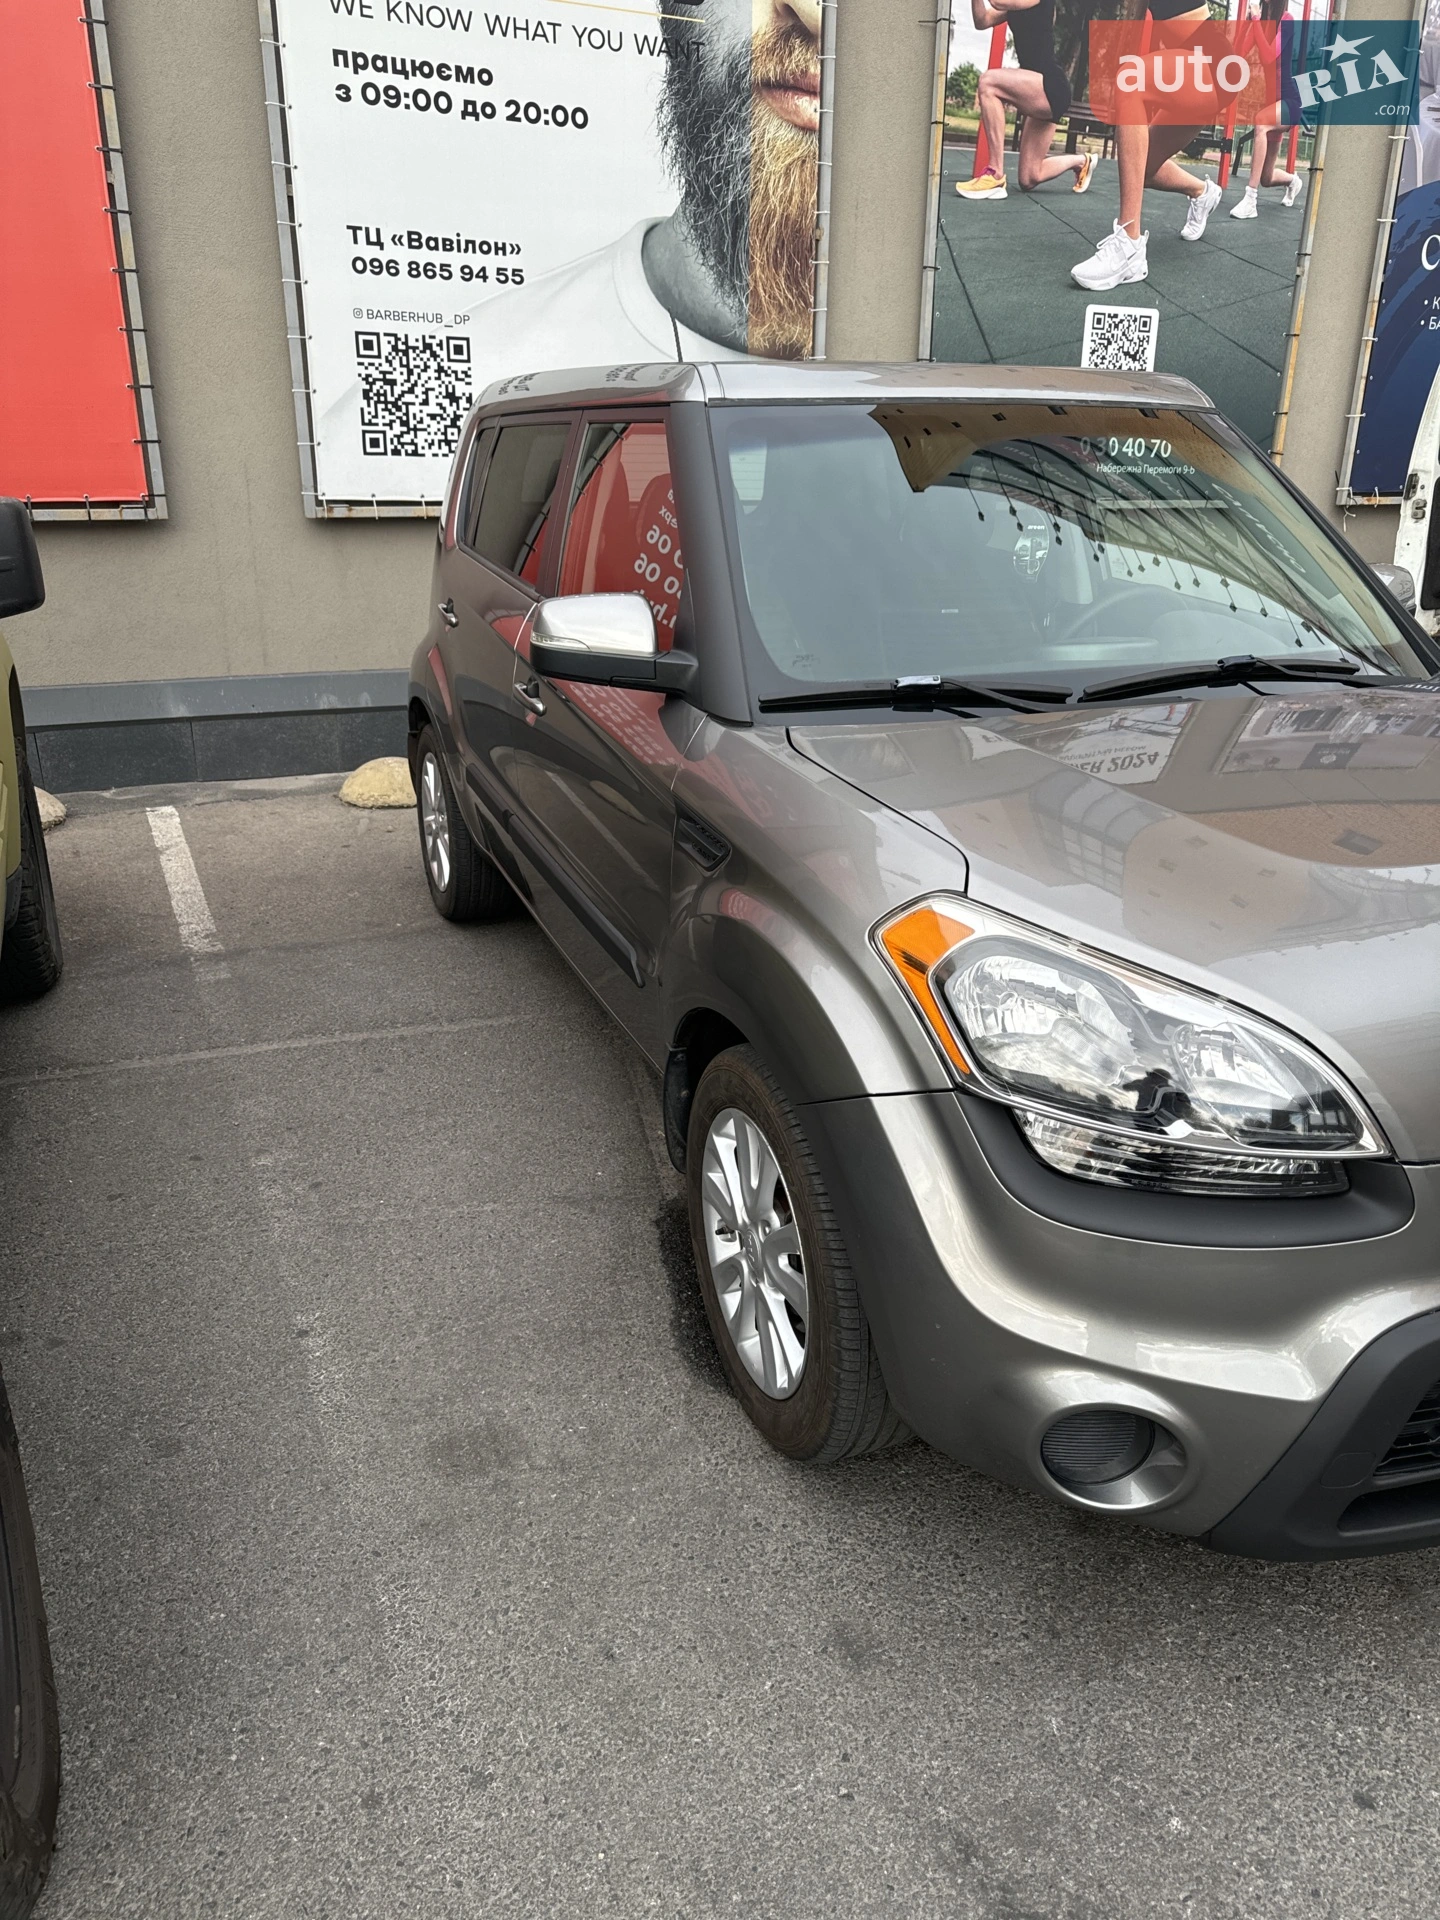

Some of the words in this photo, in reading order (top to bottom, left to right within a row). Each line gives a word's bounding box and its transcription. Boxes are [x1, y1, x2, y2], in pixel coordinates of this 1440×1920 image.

[329, 0, 374, 19] WE
[386, 0, 473, 33] KNOW
[484, 12, 562, 44] WHAT
[571, 25, 623, 53] YOU
[633, 33, 705, 62] WANT
[332, 48, 494, 87] працюємо
[335, 83, 352, 103] з
[360, 81, 453, 115] 09:00
[460, 99, 497, 122] до
[504, 99, 589, 130] 20:00
[346, 224, 385, 251] ТЦ
[390, 230, 522, 257] «Вавілон»
[351, 256, 400, 277] 096
[407, 260, 453, 281] 865
[459, 264, 489, 283] 94
[495, 267, 525, 286] 55
[366, 308, 471, 328] BARBERHUB_DP
[1121, 437, 1146, 458] 40
[1150, 438, 1172, 458] 70
[1096, 463, 1142, 476] Набережна
[1143, 463, 1182, 477] Перемоги
